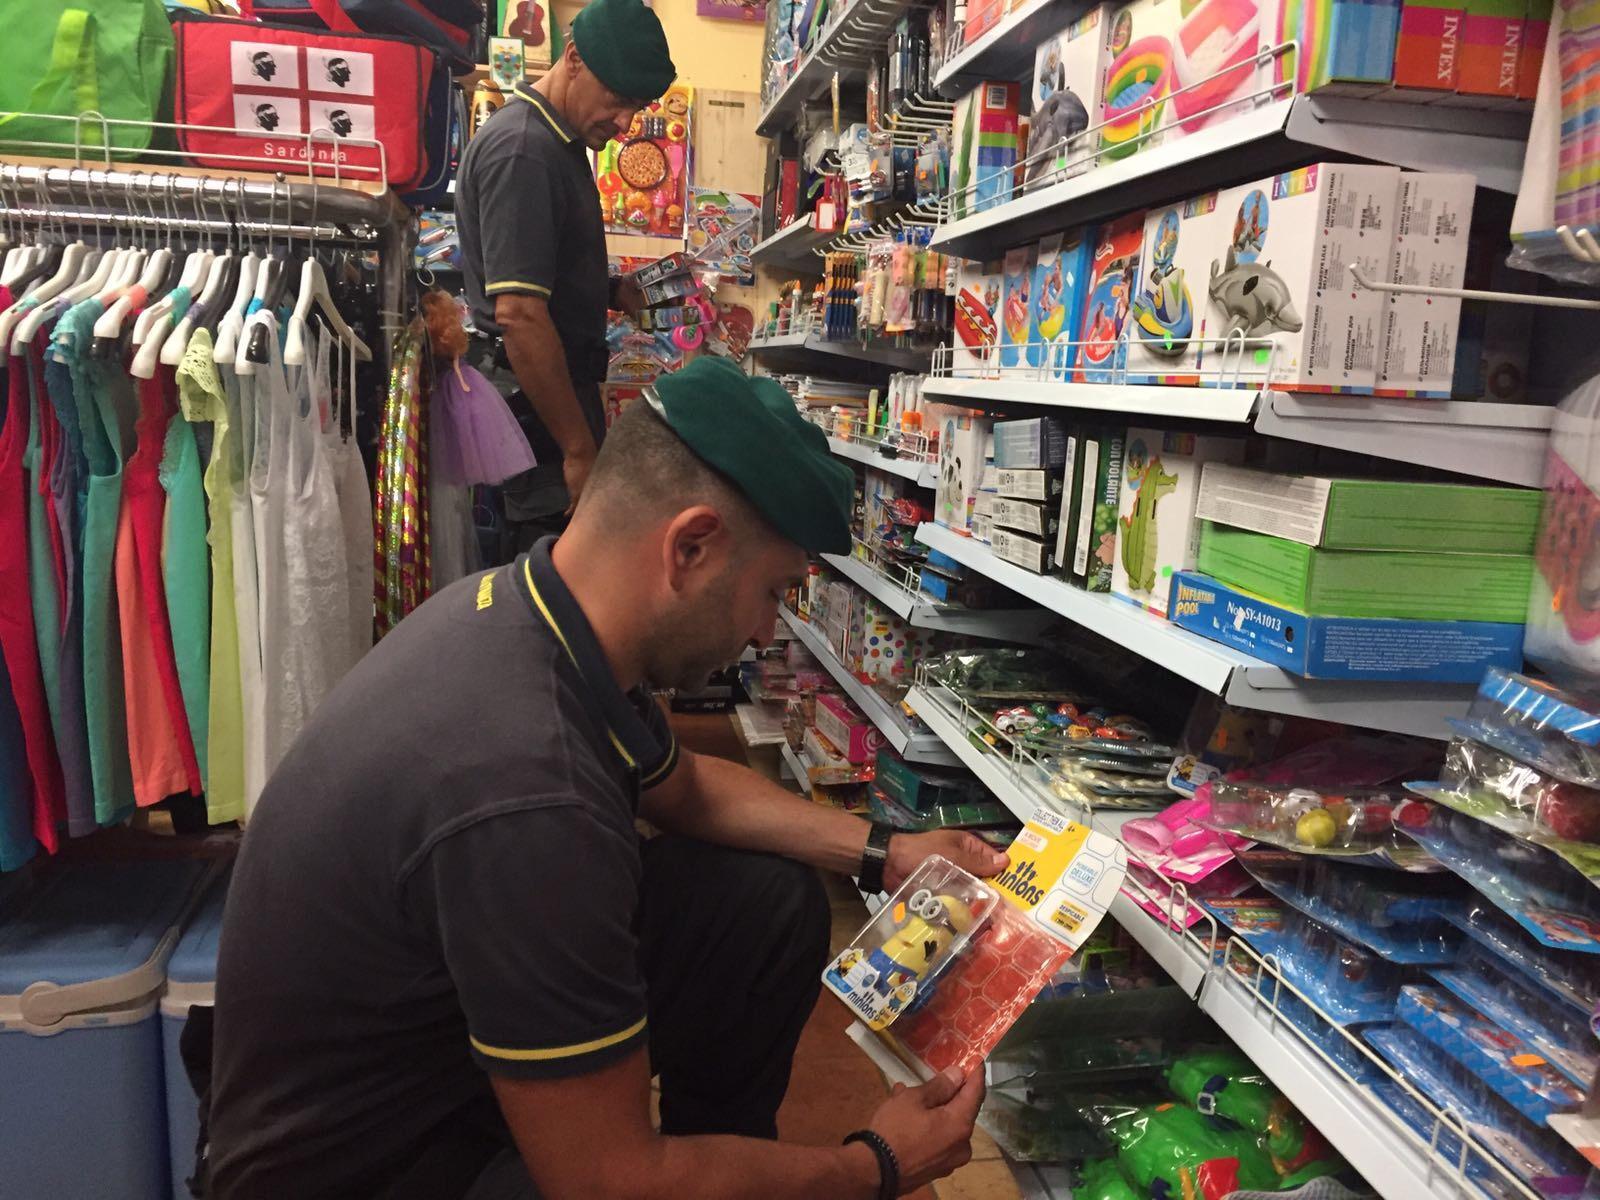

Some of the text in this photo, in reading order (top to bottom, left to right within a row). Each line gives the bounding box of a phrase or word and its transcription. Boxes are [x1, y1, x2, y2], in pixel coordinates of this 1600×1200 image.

[1438, 16, 1459, 80] INTEX
[1500, 25, 1520, 88] INTEX
[264, 143, 347, 161] Sardinia
[1106, 461, 1121, 505] VOLANTE
[1175, 602, 1198, 616] POOL
[1071, 868, 1095, 885] DELUXE
[848, 991, 876, 1019] minions
